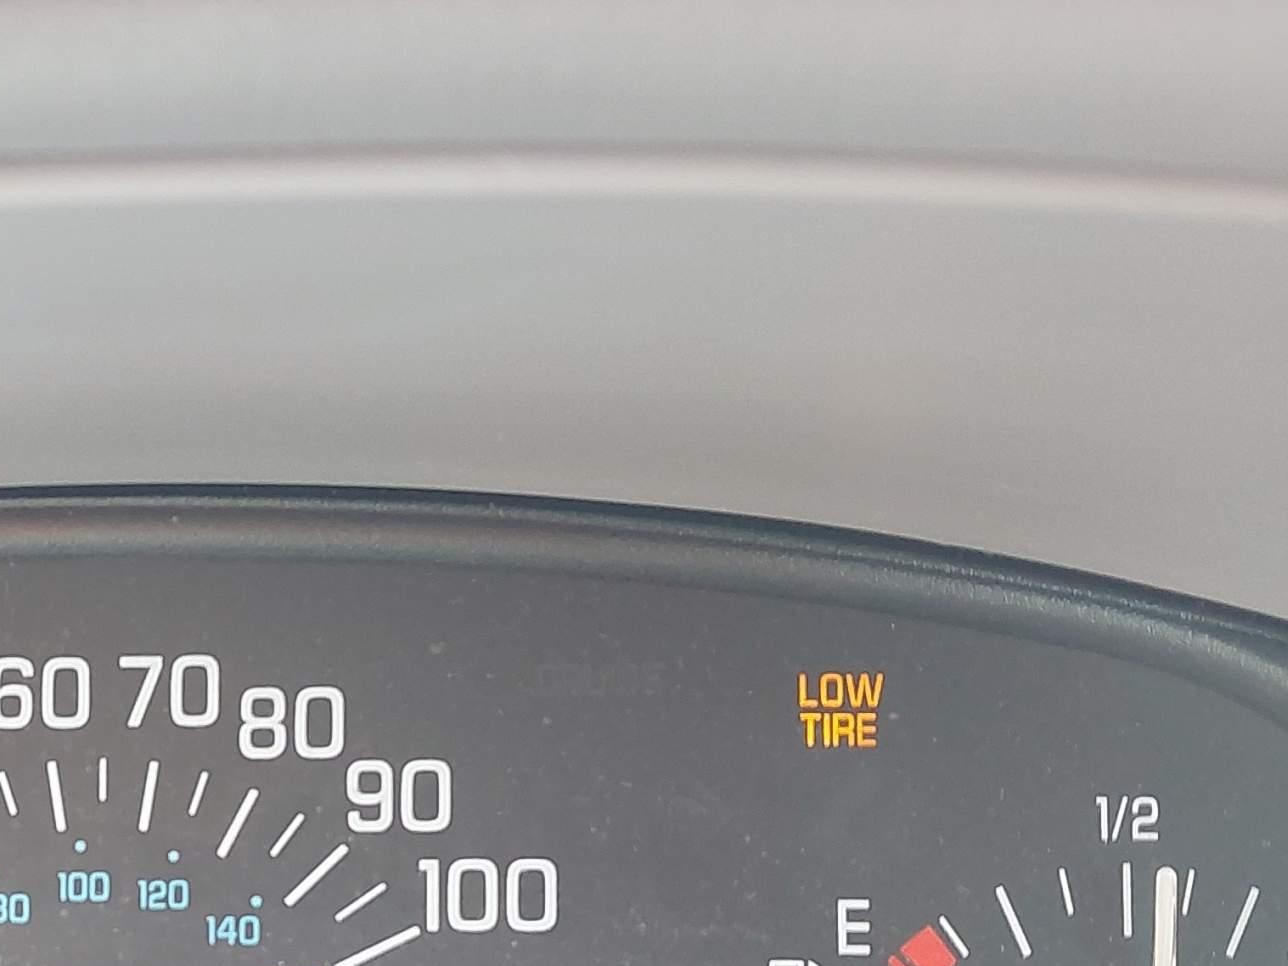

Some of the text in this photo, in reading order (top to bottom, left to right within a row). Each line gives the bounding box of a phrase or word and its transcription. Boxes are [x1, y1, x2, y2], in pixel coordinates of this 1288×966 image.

[120, 655, 219, 727] 70
[800, 674, 883, 708] LOW
[239, 687, 344, 759] 80
[800, 713, 876, 747] TIRE
[347, 760, 450, 832] 90
[1096, 796, 1158, 842] 1/2
[58, 872, 109, 901] 100
[138, 880, 188, 909] 120
[417, 858, 558, 932] 100
[207, 916, 259, 945] 140
[838, 899, 870, 955] E
